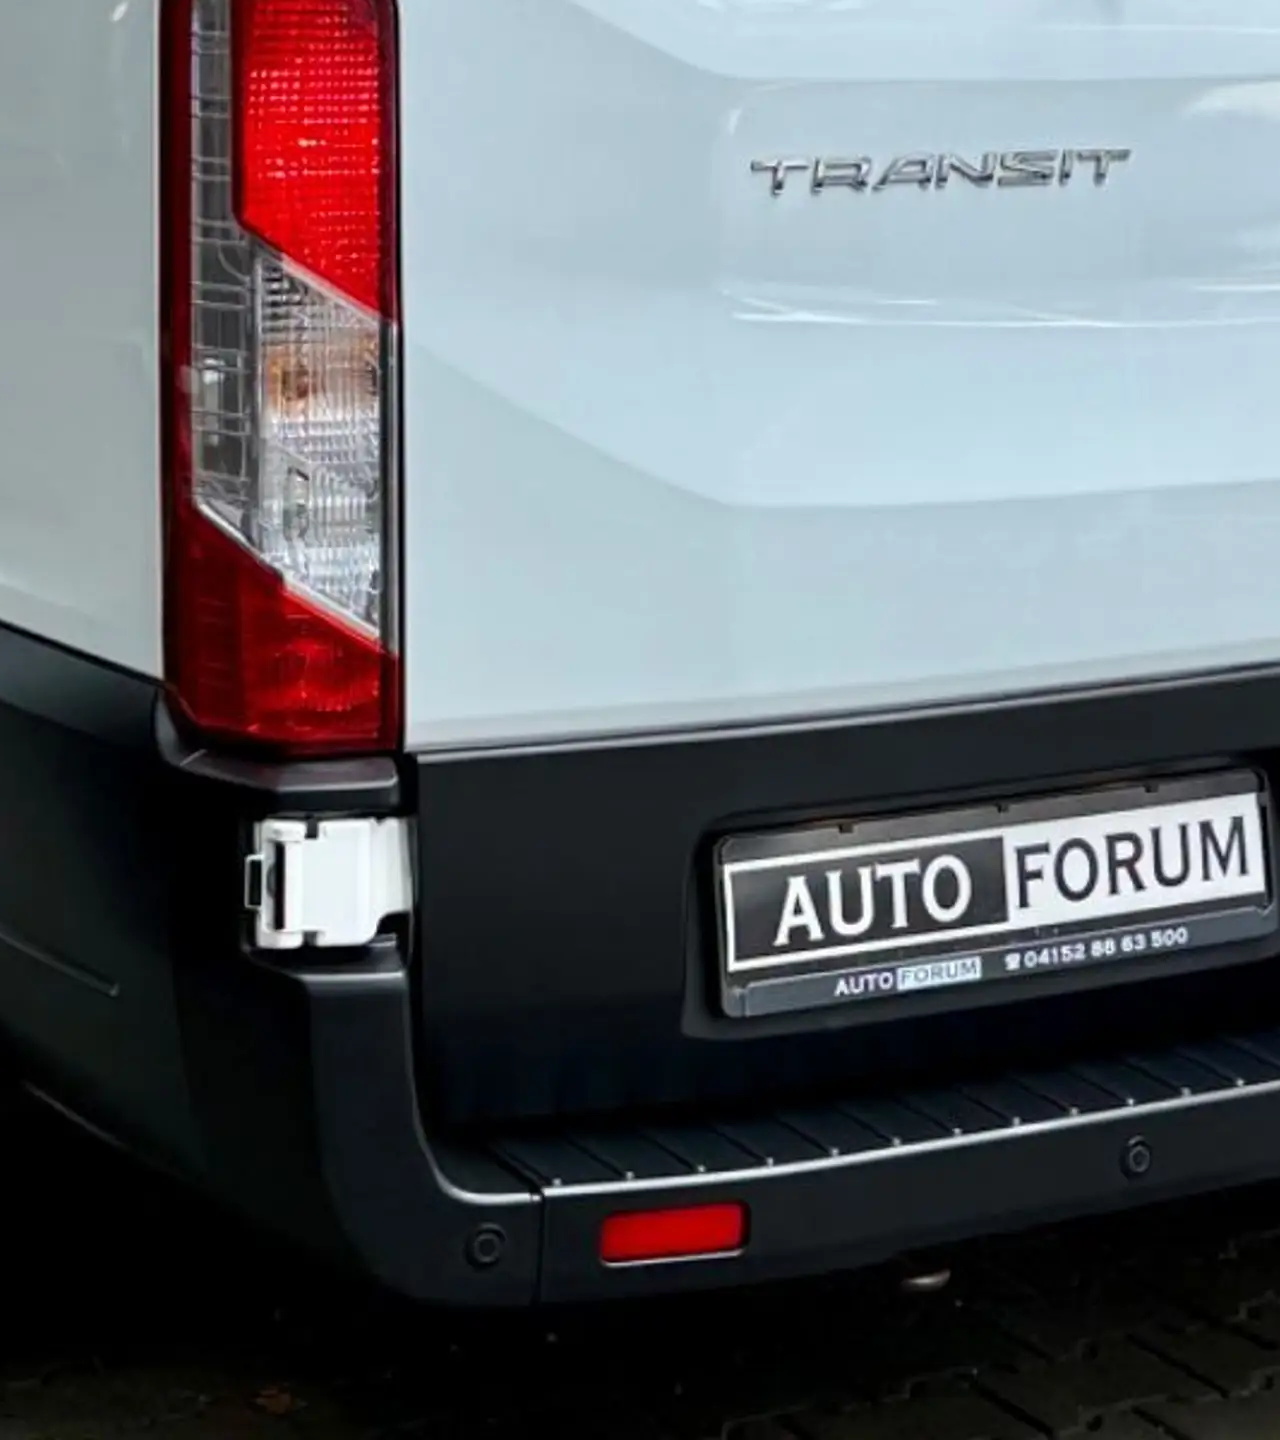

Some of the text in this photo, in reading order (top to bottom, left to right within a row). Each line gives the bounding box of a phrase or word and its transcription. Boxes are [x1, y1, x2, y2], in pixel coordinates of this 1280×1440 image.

[750, 148, 1132, 196] TRANSIT
[773, 816, 1249, 947] AUTO FORUM
[834, 971, 894, 997] AUTO
[901, 962, 978, 984] FORUM
[1024, 942, 1086, 968] 04152
[1151, 926, 1188, 947] 500
